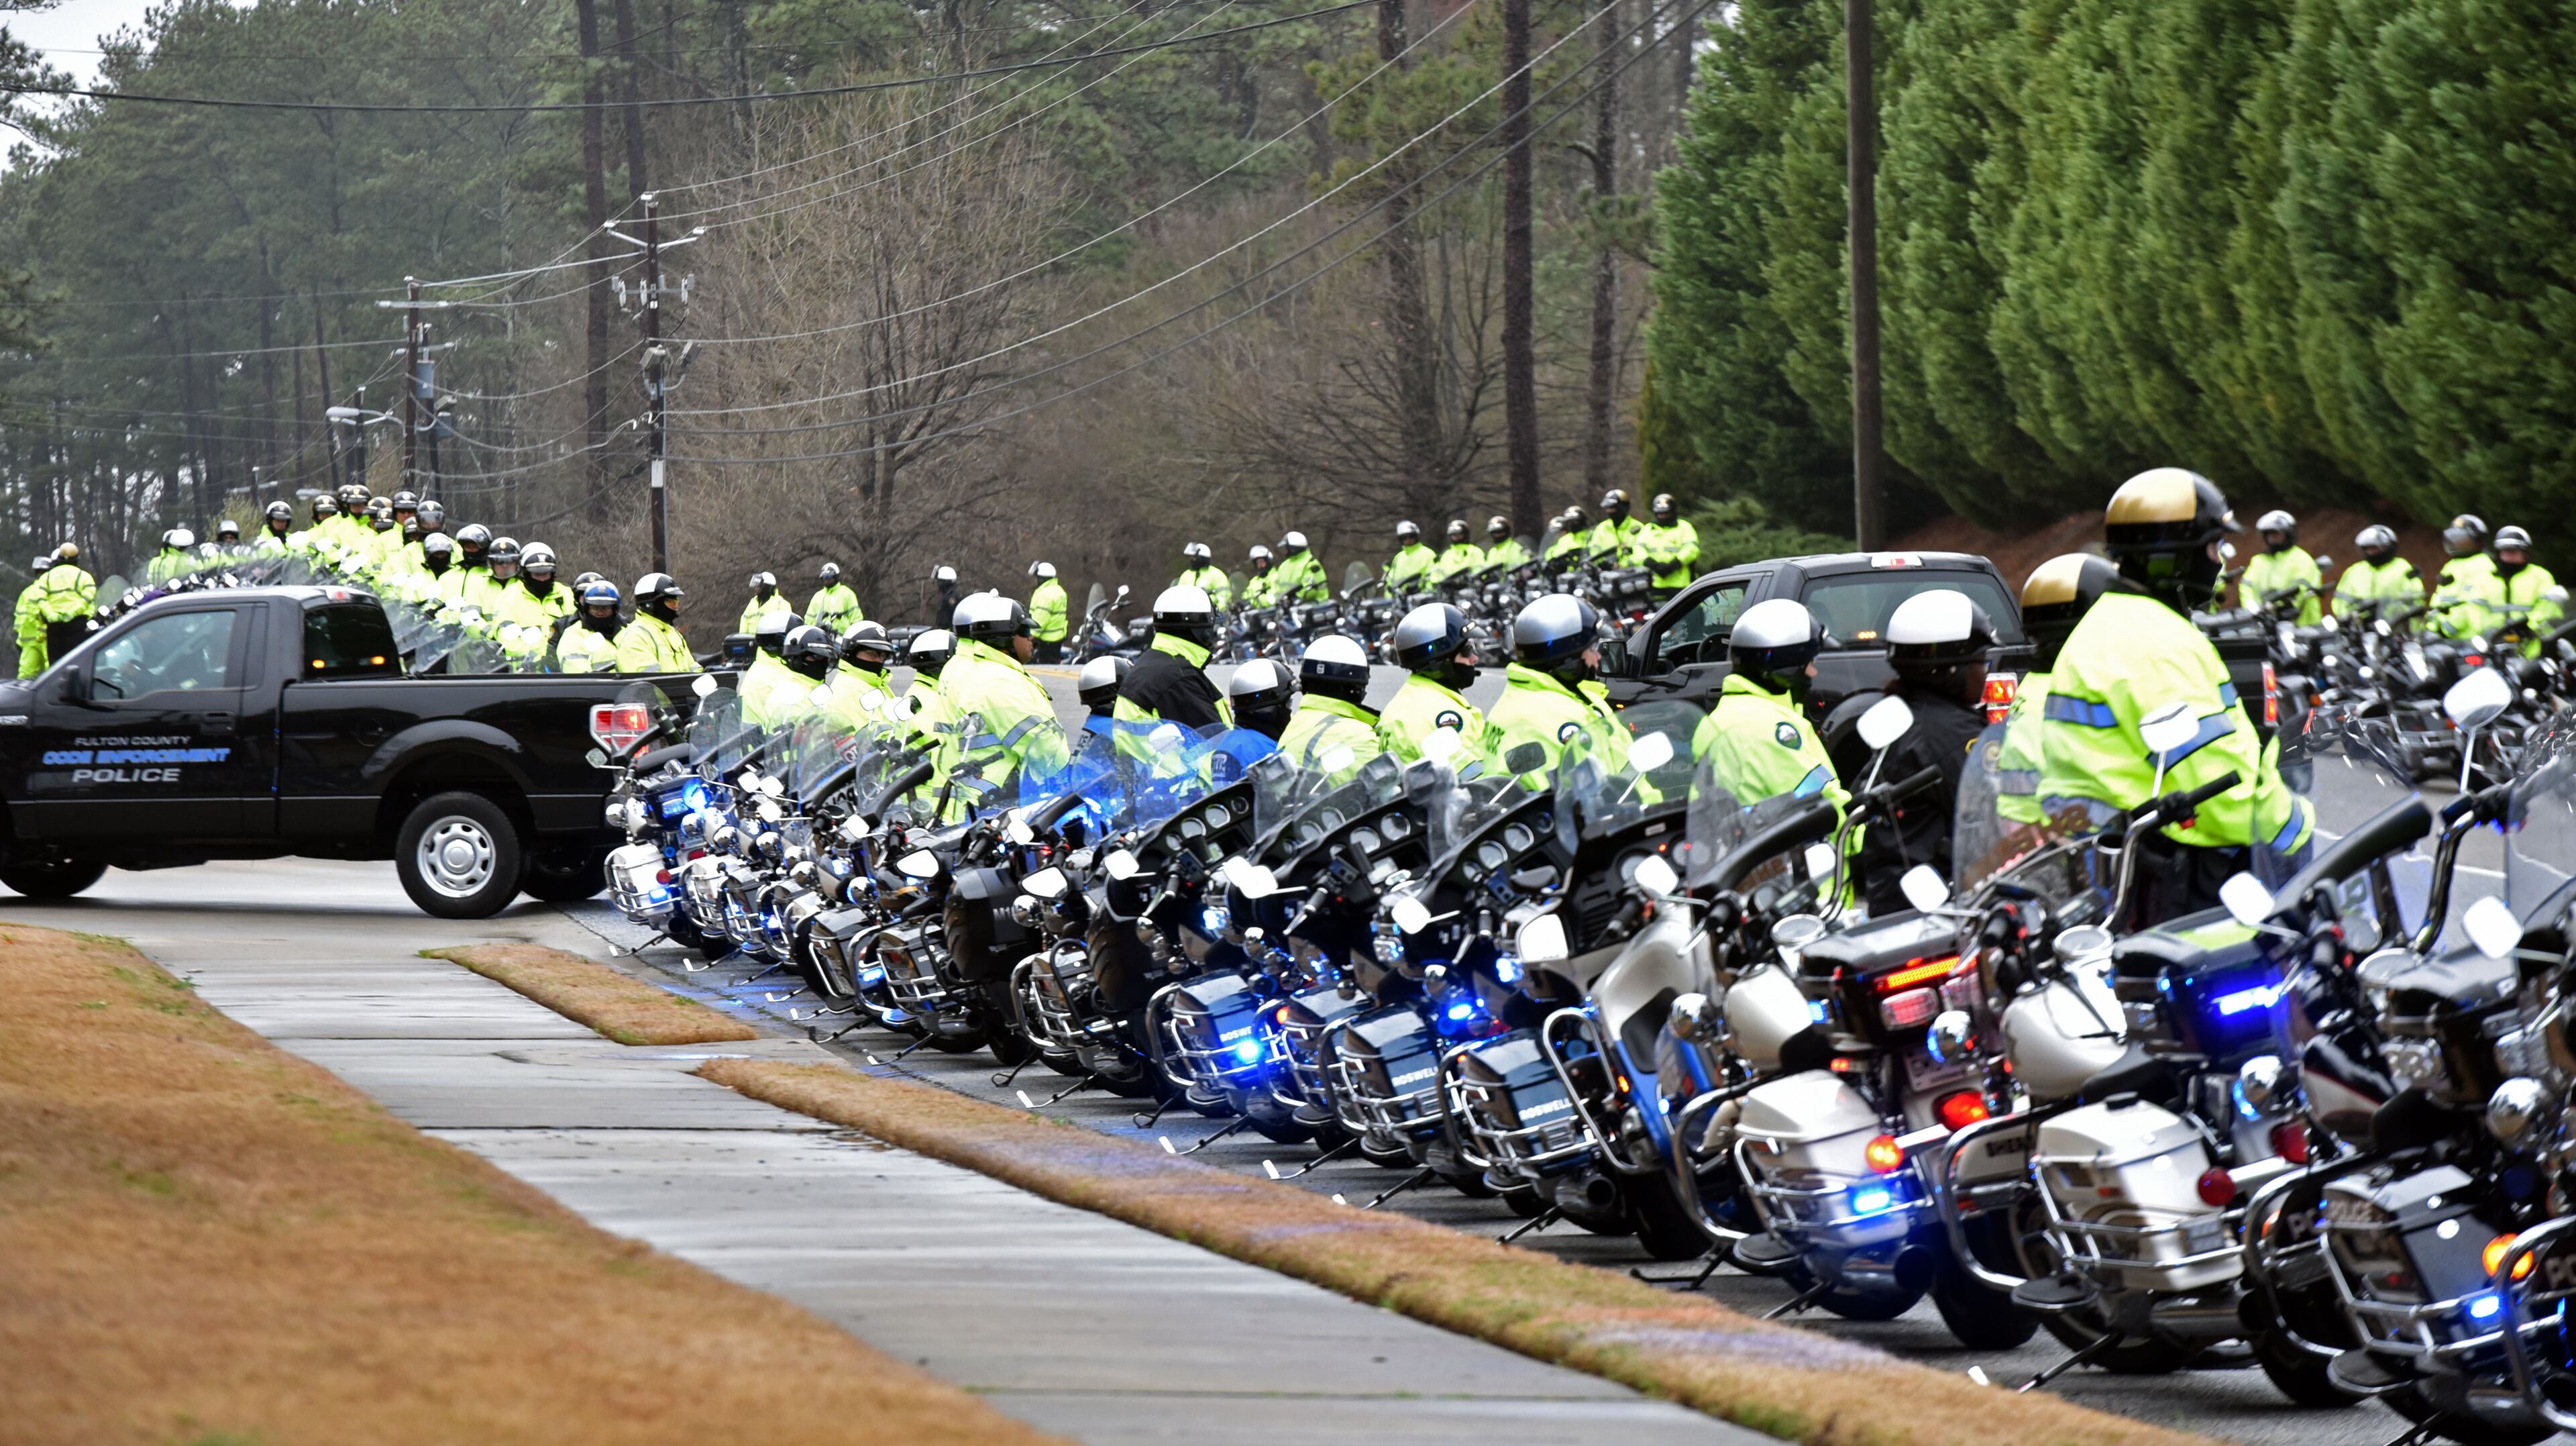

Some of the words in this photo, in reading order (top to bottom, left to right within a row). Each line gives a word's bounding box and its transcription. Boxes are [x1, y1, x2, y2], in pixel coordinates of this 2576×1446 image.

[74, 736, 129, 746] FULTON
[131, 735, 191, 745] COUNTY
[96, 747, 231, 764] ENFORCEMENT
[72, 768, 181, 782] POLICE
